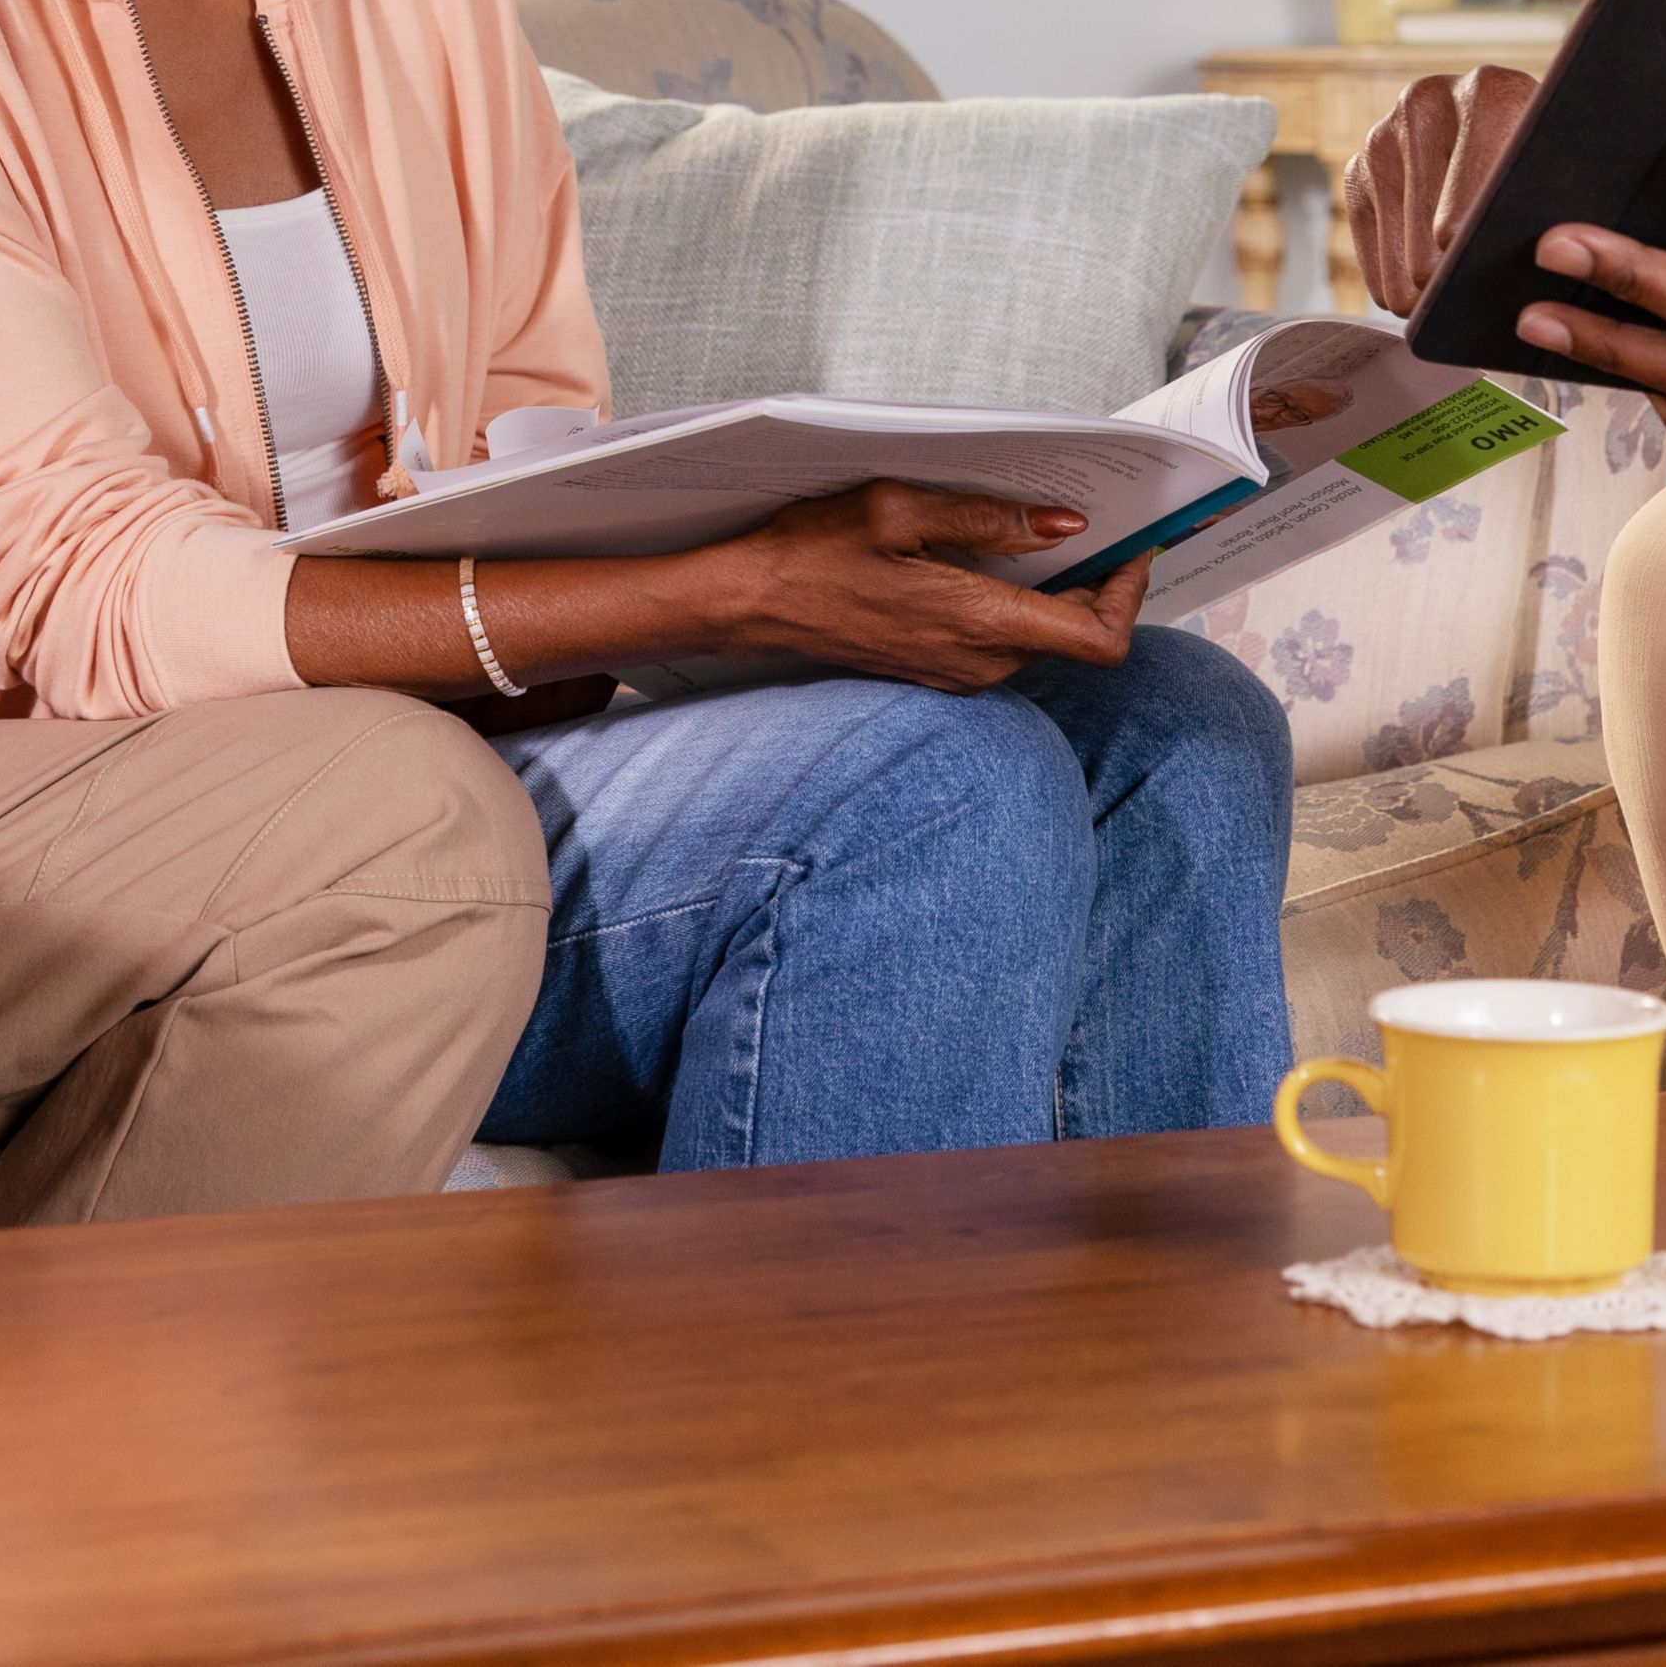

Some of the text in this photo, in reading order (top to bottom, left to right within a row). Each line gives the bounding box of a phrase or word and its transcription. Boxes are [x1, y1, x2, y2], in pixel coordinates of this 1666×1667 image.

[1460, 392, 1489, 407] Select
[1421, 406, 1461, 428] Counties
[1472, 404, 1511, 424] Humana
[1398, 431, 1414, 440] MS
[1450, 423, 1474, 435] Gold
[1471, 415, 1539, 450] HMO
[1432, 434, 1453, 445] Plus
[1301, 478, 1350, 501] Madison,
[1277, 502, 1306, 518] Pearl
[1218, 530, 1254, 547] Rankin
